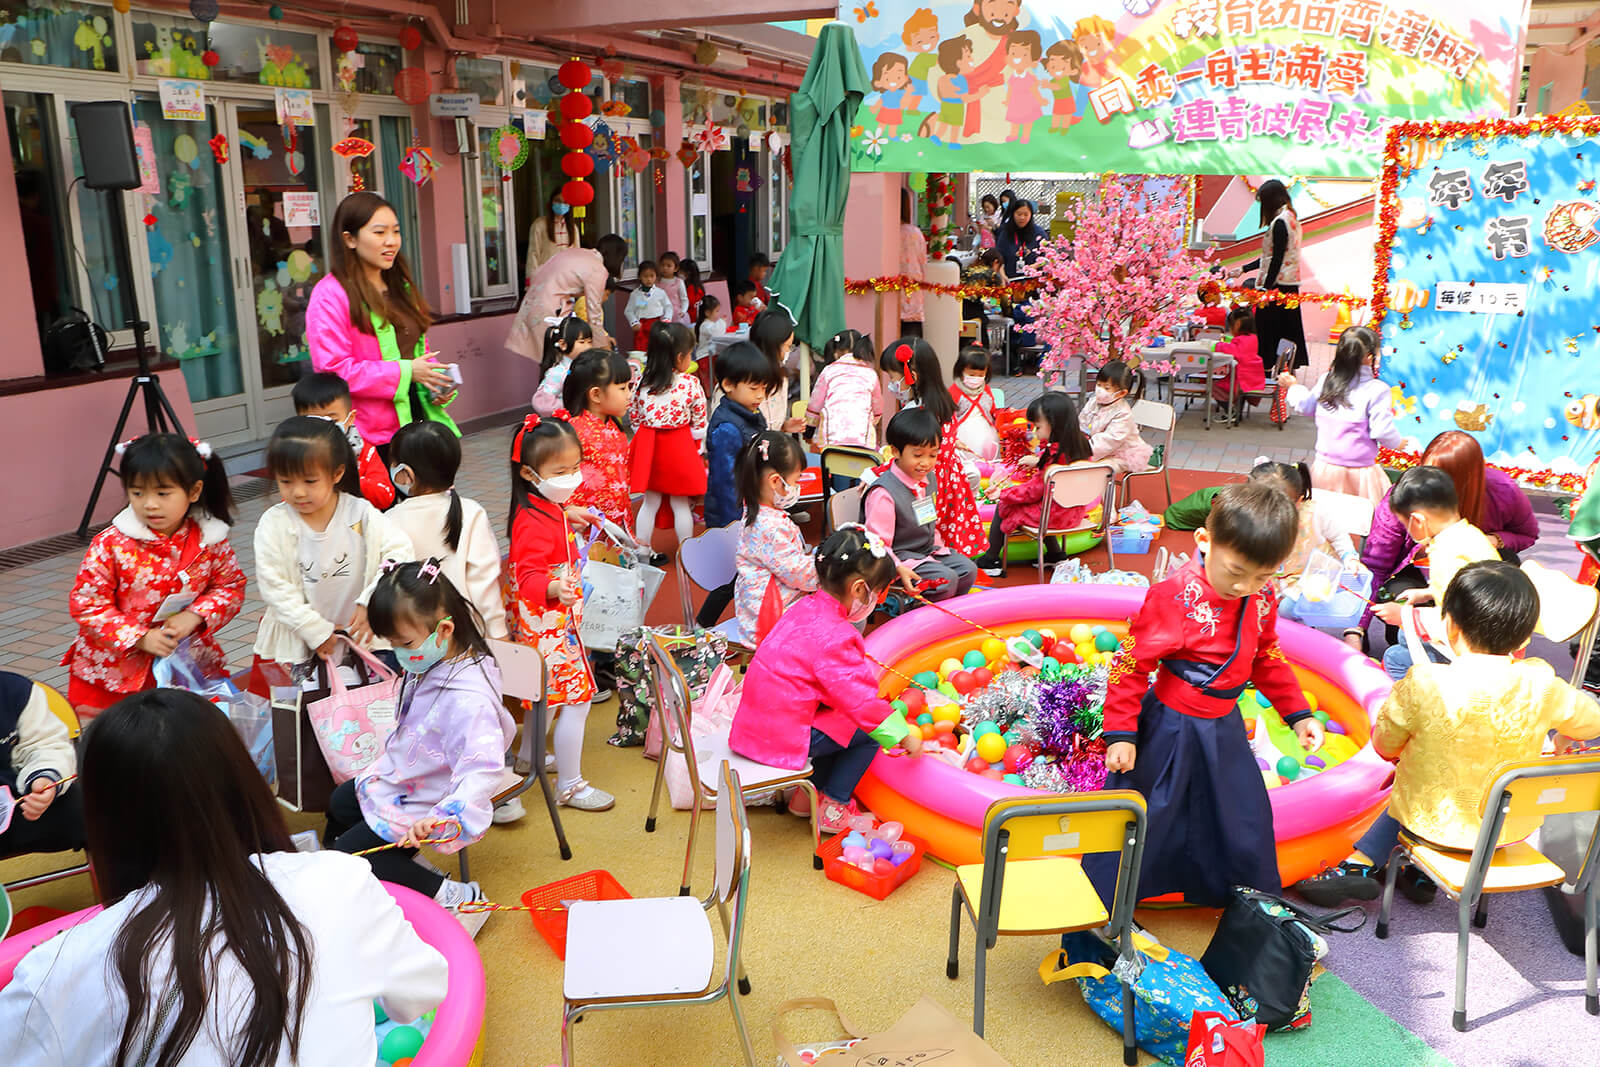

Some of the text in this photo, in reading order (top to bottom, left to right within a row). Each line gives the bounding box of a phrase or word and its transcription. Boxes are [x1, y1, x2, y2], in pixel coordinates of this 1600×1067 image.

[1087, 43, 1367, 124] 同乘一舟主滿愛
[1429, 160, 1527, 209] 年年
[1504, 293, 1518, 306] 元
